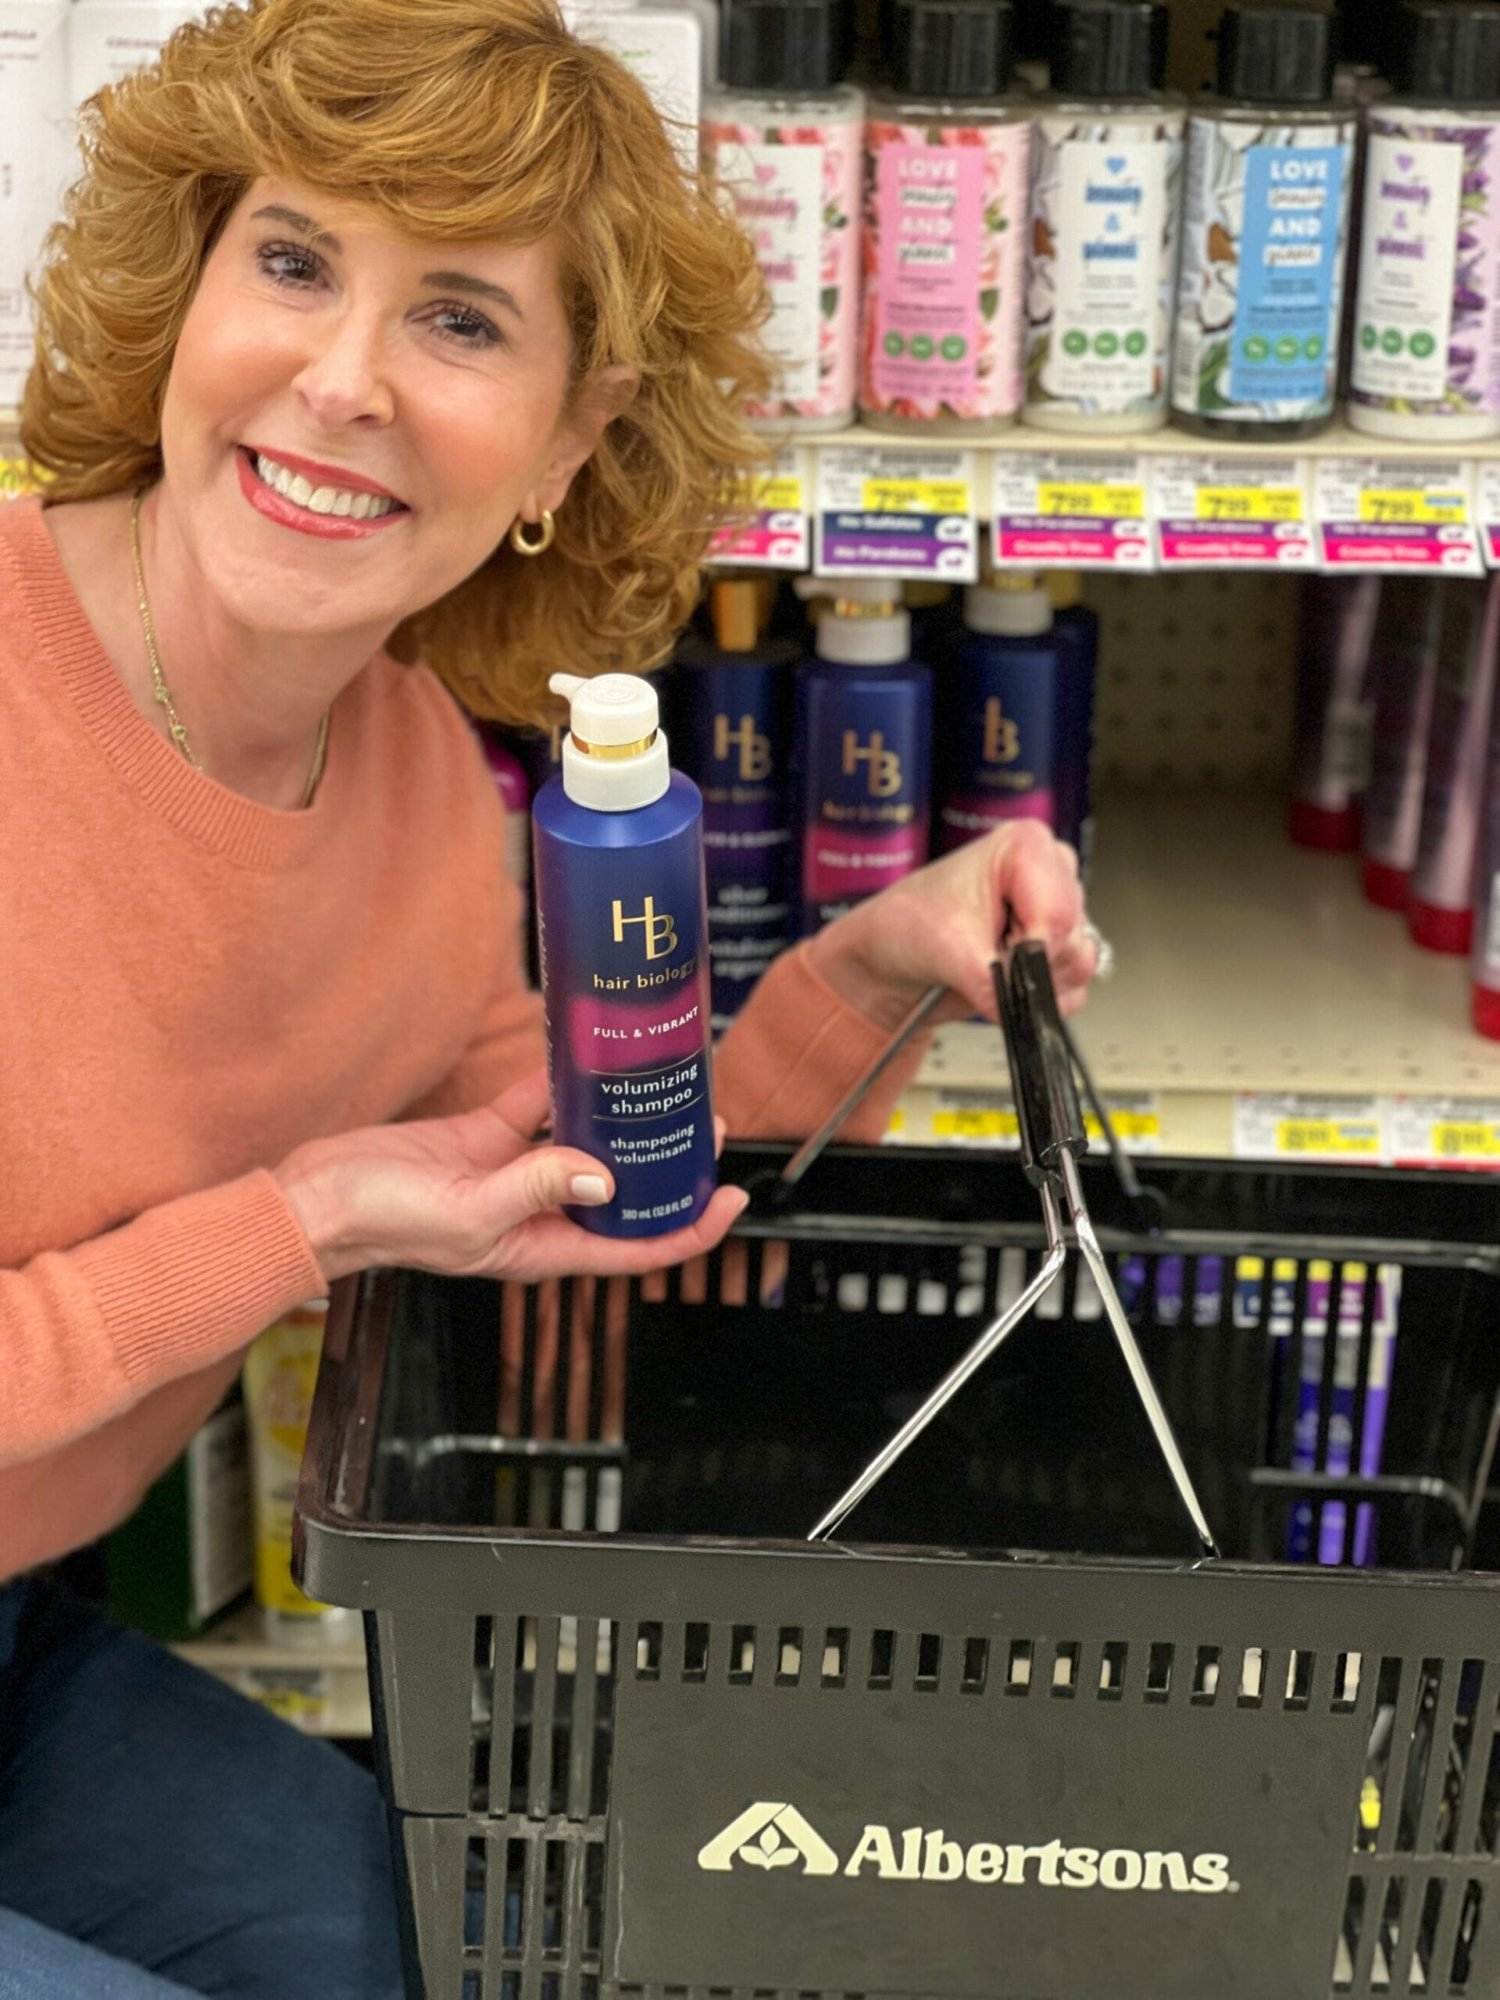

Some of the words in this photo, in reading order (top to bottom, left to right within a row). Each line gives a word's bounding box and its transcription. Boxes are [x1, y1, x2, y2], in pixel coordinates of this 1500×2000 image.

[899, 159, 957, 179] LOVE
[1269, 160, 1328, 180] LOVE
[901, 218, 954, 236] AND
[1268, 218, 1322, 237] AND
[842, 729, 902, 797] HB
[612, 896, 678, 960] HB
[593, 974, 630, 990] hair
[593, 1027, 627, 1039] FULL
[633, 1028, 643, 1038] &
[648, 1006, 698, 1035] VIBRANT
[601, 1063, 698, 1095] volumizing
[611, 1088, 692, 1114] shampoo
[610, 1123, 695, 1150] shampooing
[614, 1139, 692, 1164] volumisant
[844, 1825, 1231, 1893] Albertsons
